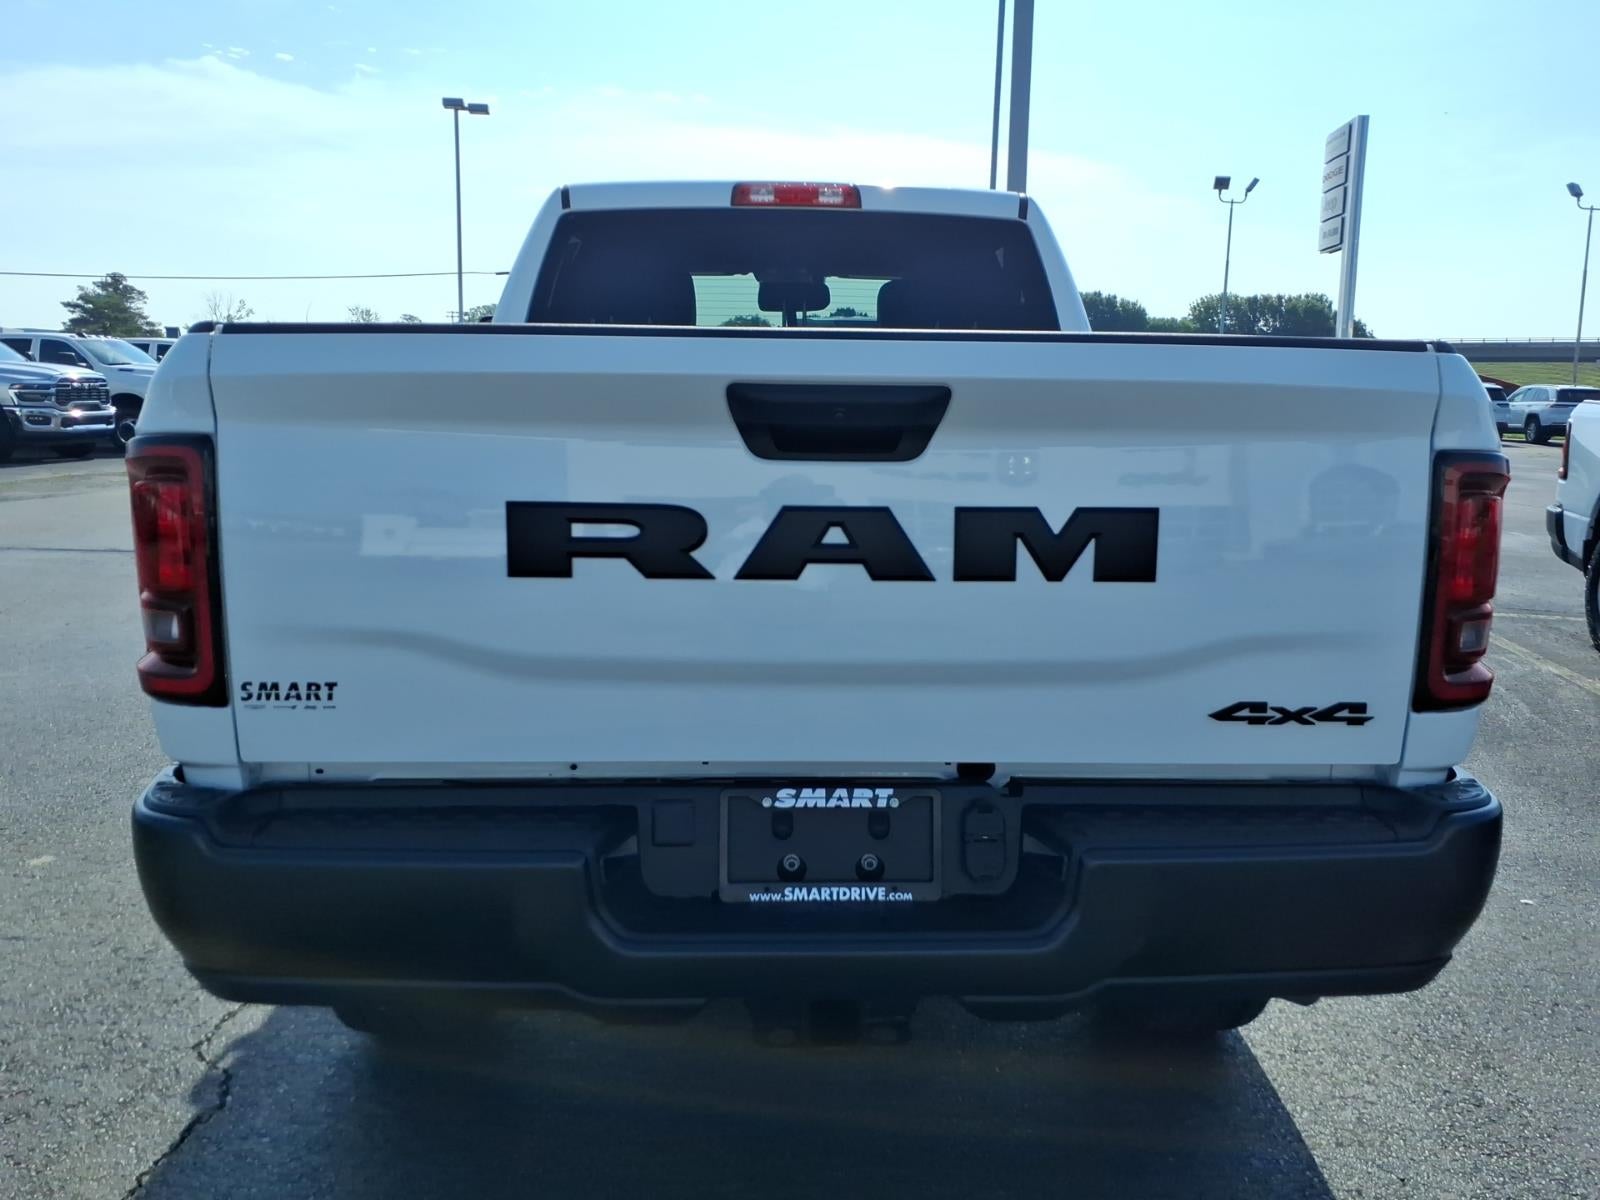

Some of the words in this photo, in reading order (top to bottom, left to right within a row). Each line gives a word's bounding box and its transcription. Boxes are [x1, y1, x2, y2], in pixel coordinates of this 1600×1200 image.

[505, 500, 1160, 583] RAM
[240, 681, 338, 702] SMART
[1208, 701, 1375, 726] 4x4
[774, 787, 894, 808] SMART
